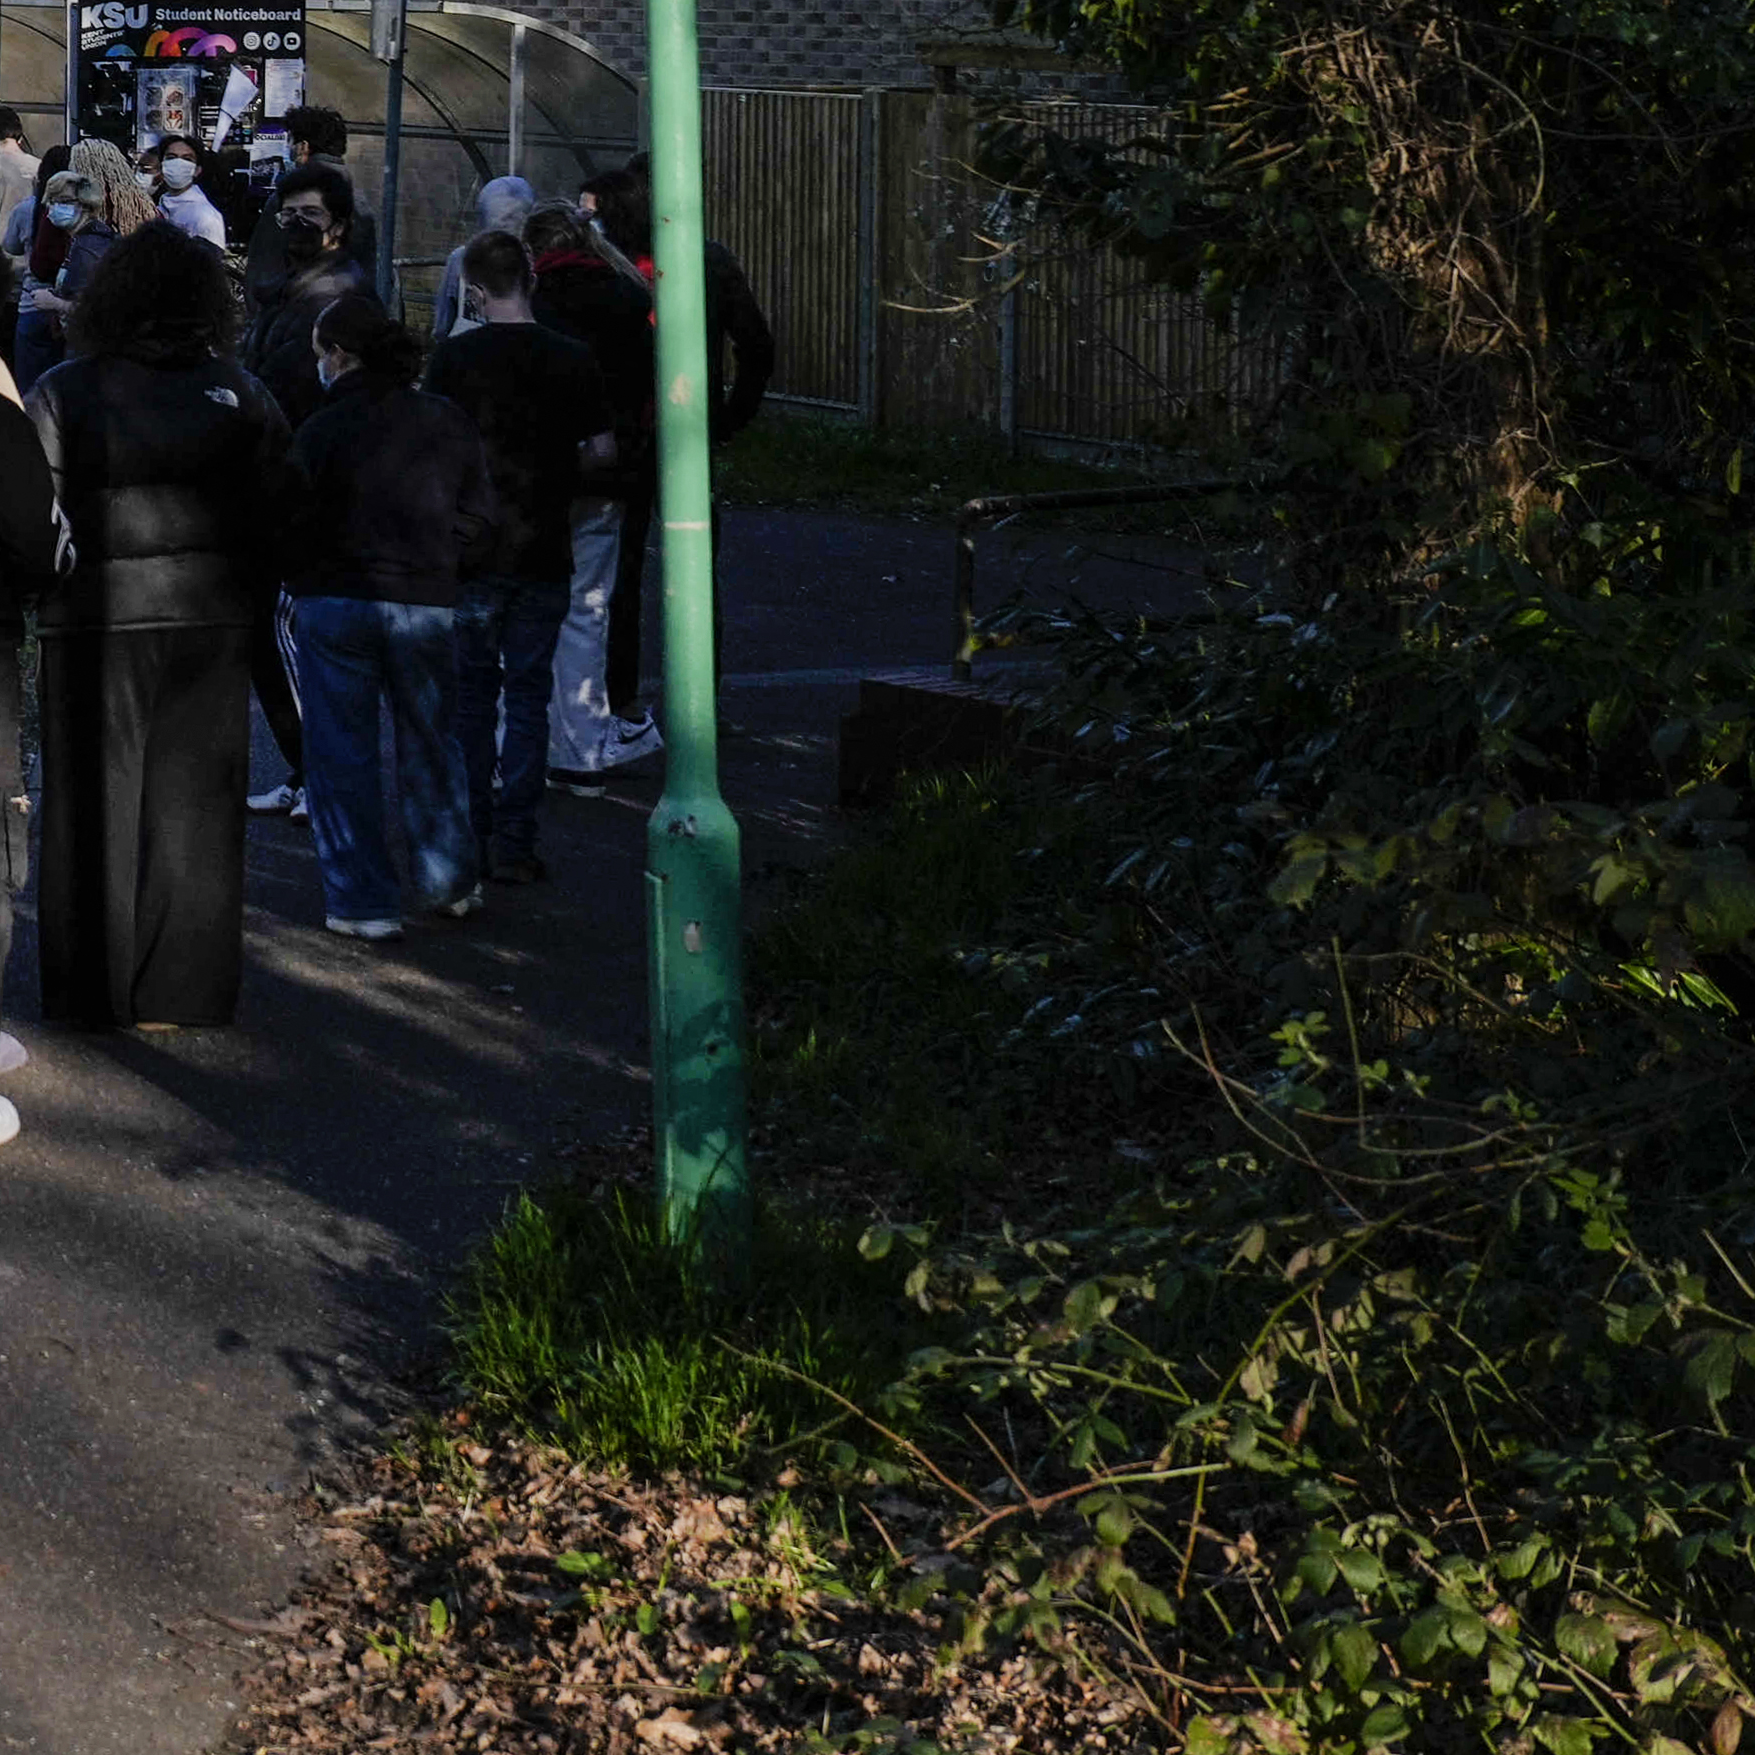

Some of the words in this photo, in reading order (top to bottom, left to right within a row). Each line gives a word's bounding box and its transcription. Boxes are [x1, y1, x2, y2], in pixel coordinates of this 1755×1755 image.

[81, 1, 149, 29] KSU
[155, 8, 212, 21] Student
[214, 8, 301, 21] Noticeboard
[81, 28, 105, 39] KENT
